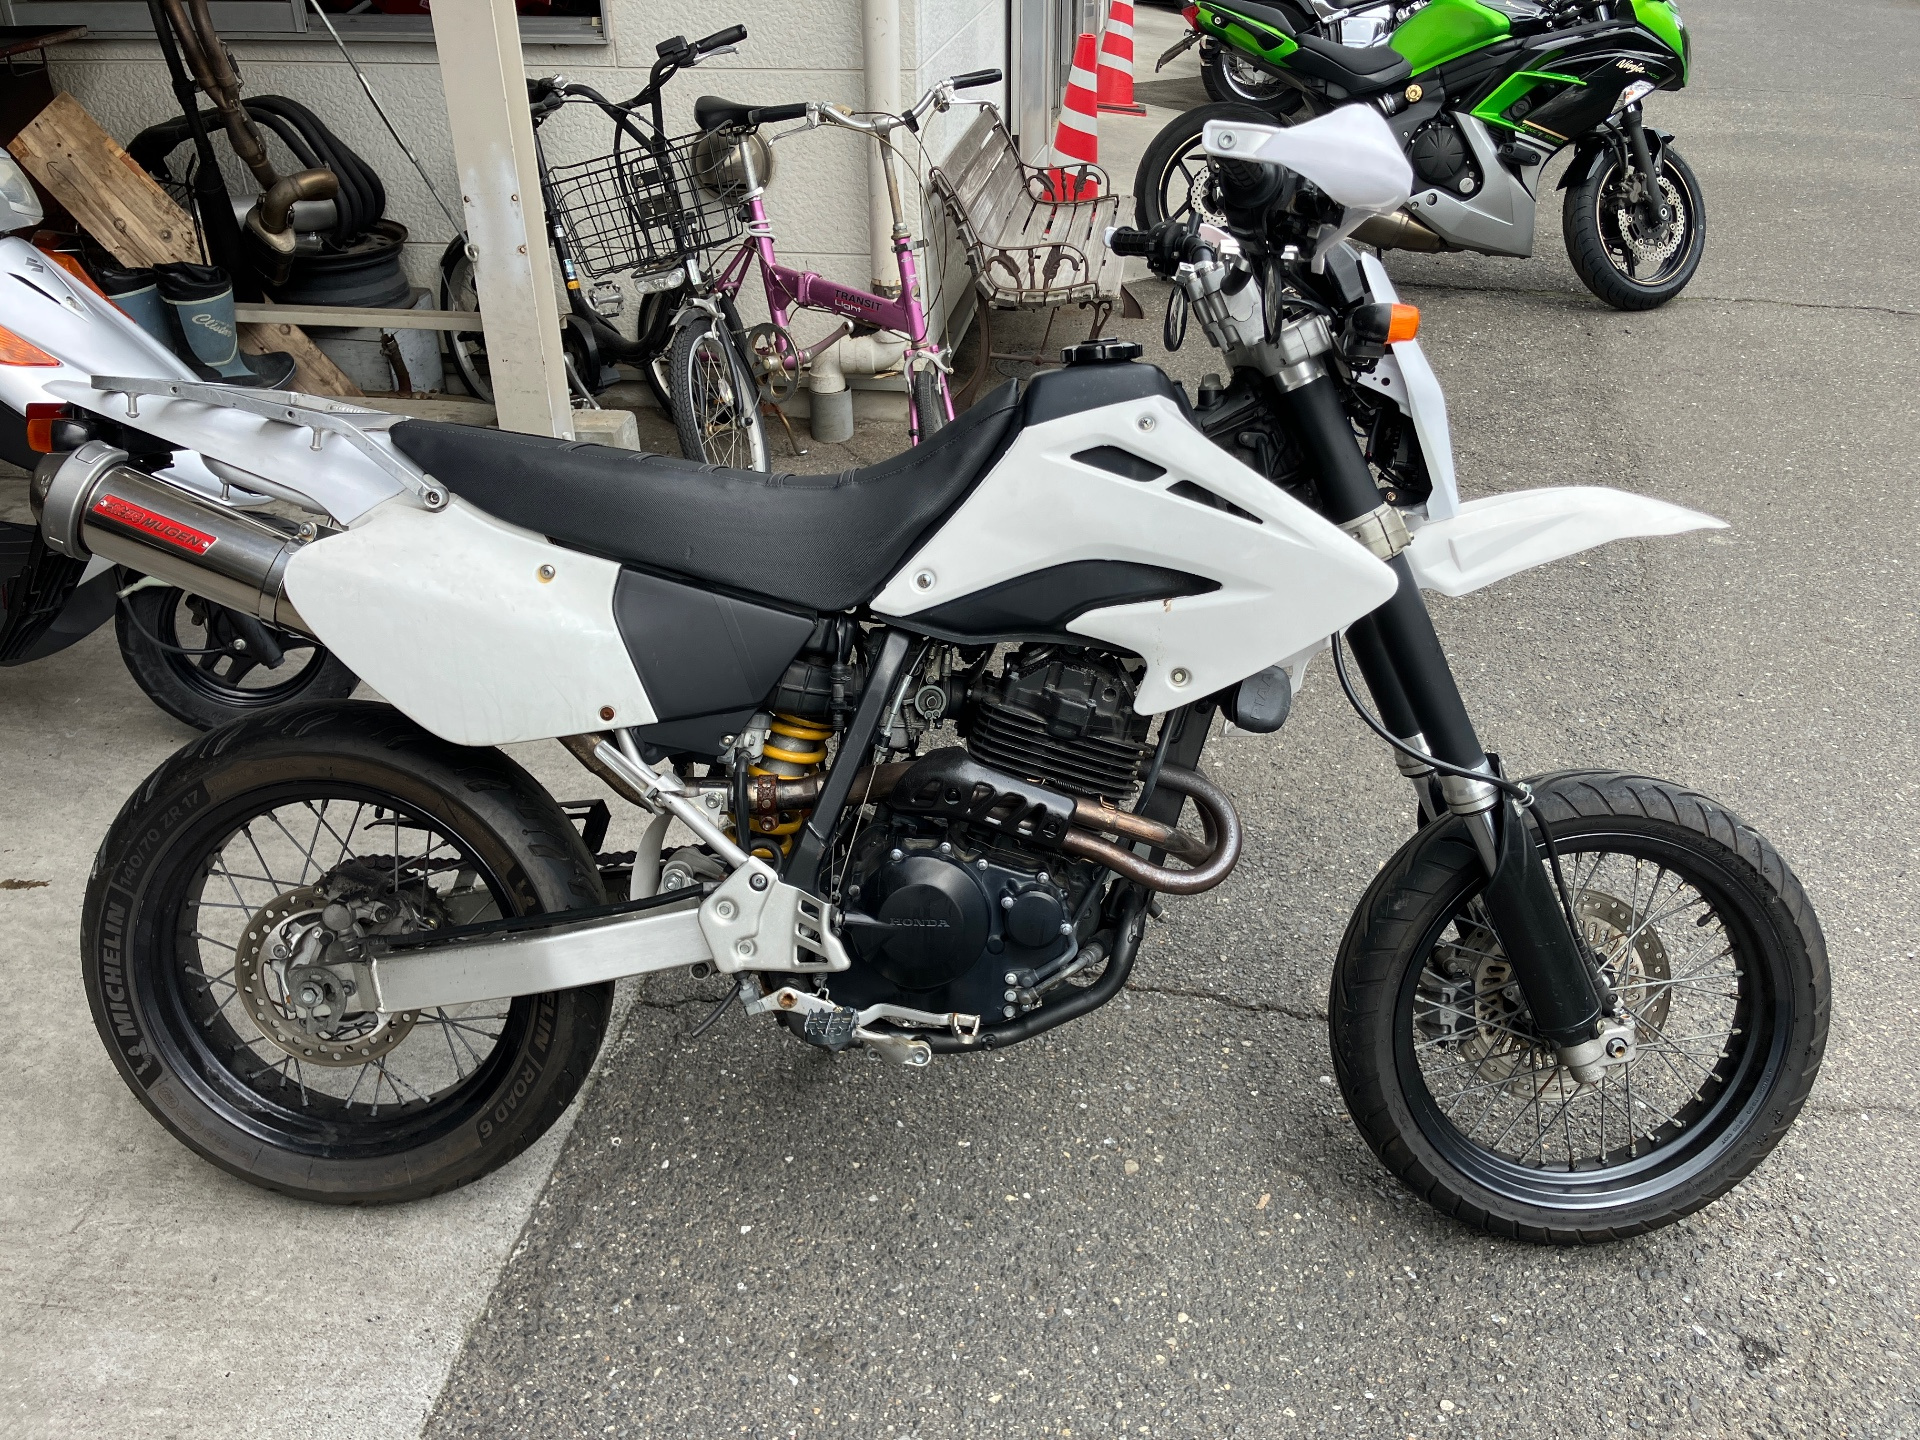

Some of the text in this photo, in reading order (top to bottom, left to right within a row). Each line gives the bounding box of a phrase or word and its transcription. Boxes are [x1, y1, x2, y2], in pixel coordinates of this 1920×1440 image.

[1615, 58, 1646, 74] Ninja
[834, 299, 862, 313] Light
[835, 289, 882, 311] TRANSIT
[141, 517, 203, 546] MUGEN
[1249, 673, 1275, 721] PIAA
[119, 789, 199, 887] 140/70 ZR 17
[889, 917, 951, 928] HONDA
[102, 902, 138, 1038] MICHELIN
[533, 992, 555, 1052] ELIN
[479, 1063, 536, 1139] ROAD 6
